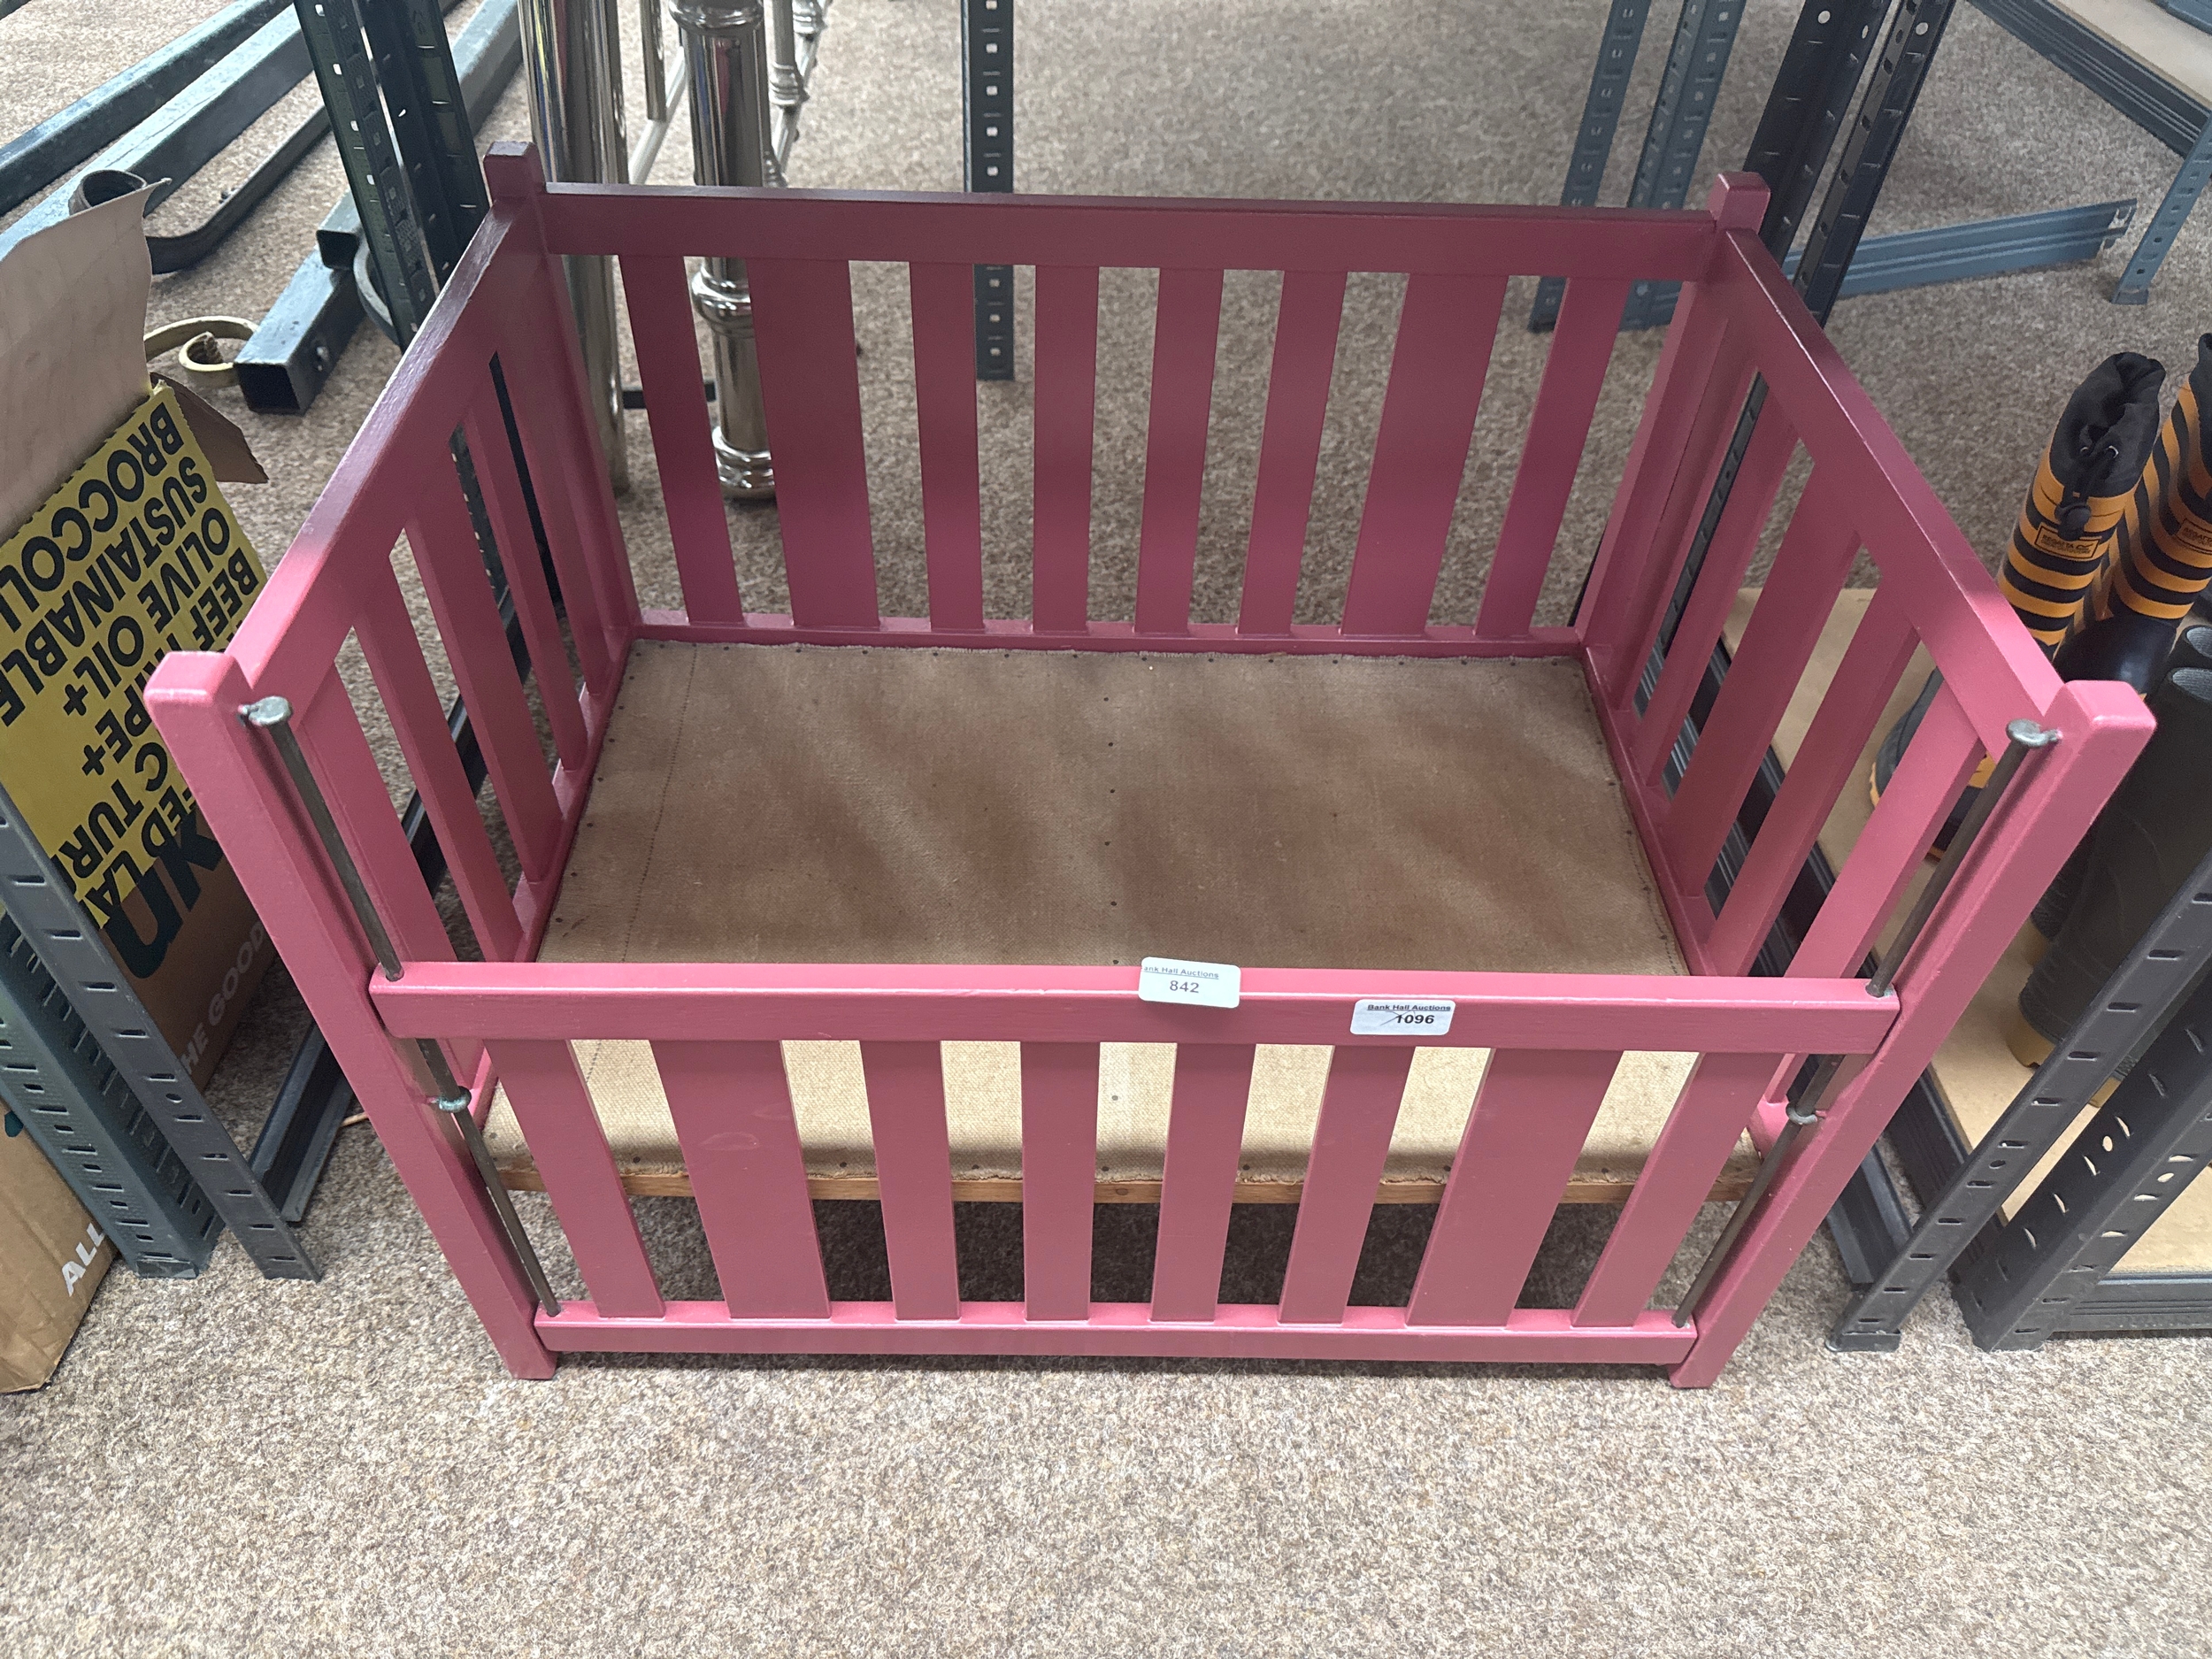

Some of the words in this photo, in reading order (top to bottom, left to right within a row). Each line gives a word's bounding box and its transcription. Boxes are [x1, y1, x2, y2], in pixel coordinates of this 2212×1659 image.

[0, 403, 184, 633] BROCCOLI
[0, 457, 207, 726] SUSTAINABLE
[137, 508, 230, 634] OLIVE
[190, 548, 259, 650] BEEF
[78, 850, 146, 929] LA
[1170, 980, 1199, 993] 842
[1180, 969, 1219, 979] Auctions
[1397, 1014, 1435, 1024] 1096
[62, 1222, 105, 1297] ALL
[208, 922, 265, 1026] GOOD
